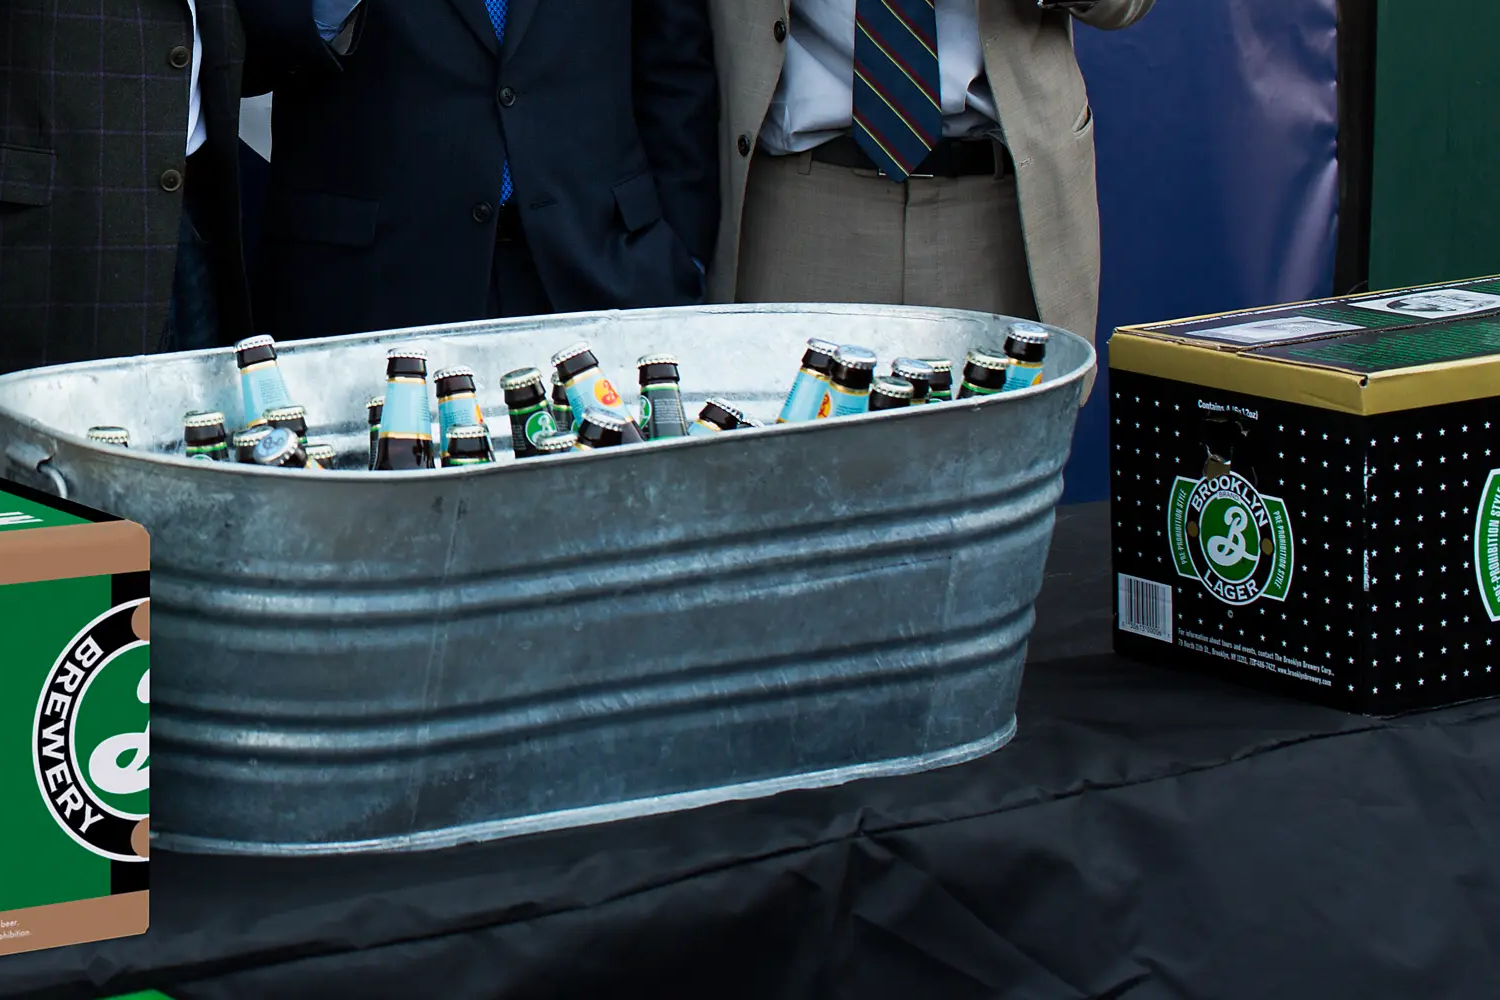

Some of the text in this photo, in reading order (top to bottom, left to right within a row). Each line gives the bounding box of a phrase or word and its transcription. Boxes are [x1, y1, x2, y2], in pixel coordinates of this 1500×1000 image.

[1198, 399, 1225, 412] Contains
[1191, 475, 1269, 528] BROOKLYN
[1490, 487, 1500, 517] STYL
[1204, 569, 1259, 601] LAGER
[1274, 568, 1285, 590] STYLE
[1209, 636, 1221, 645] about
[1222, 639, 1233, 649] tours
[1258, 650, 1274, 660] contact
[1274, 653, 1282, 662] The
[1283, 655, 1302, 668] Brooklyn
[1302, 660, 1320, 673] Brewery
[42, 634, 105, 833] BREWERY
[0, 919, 20, 928] beer.
